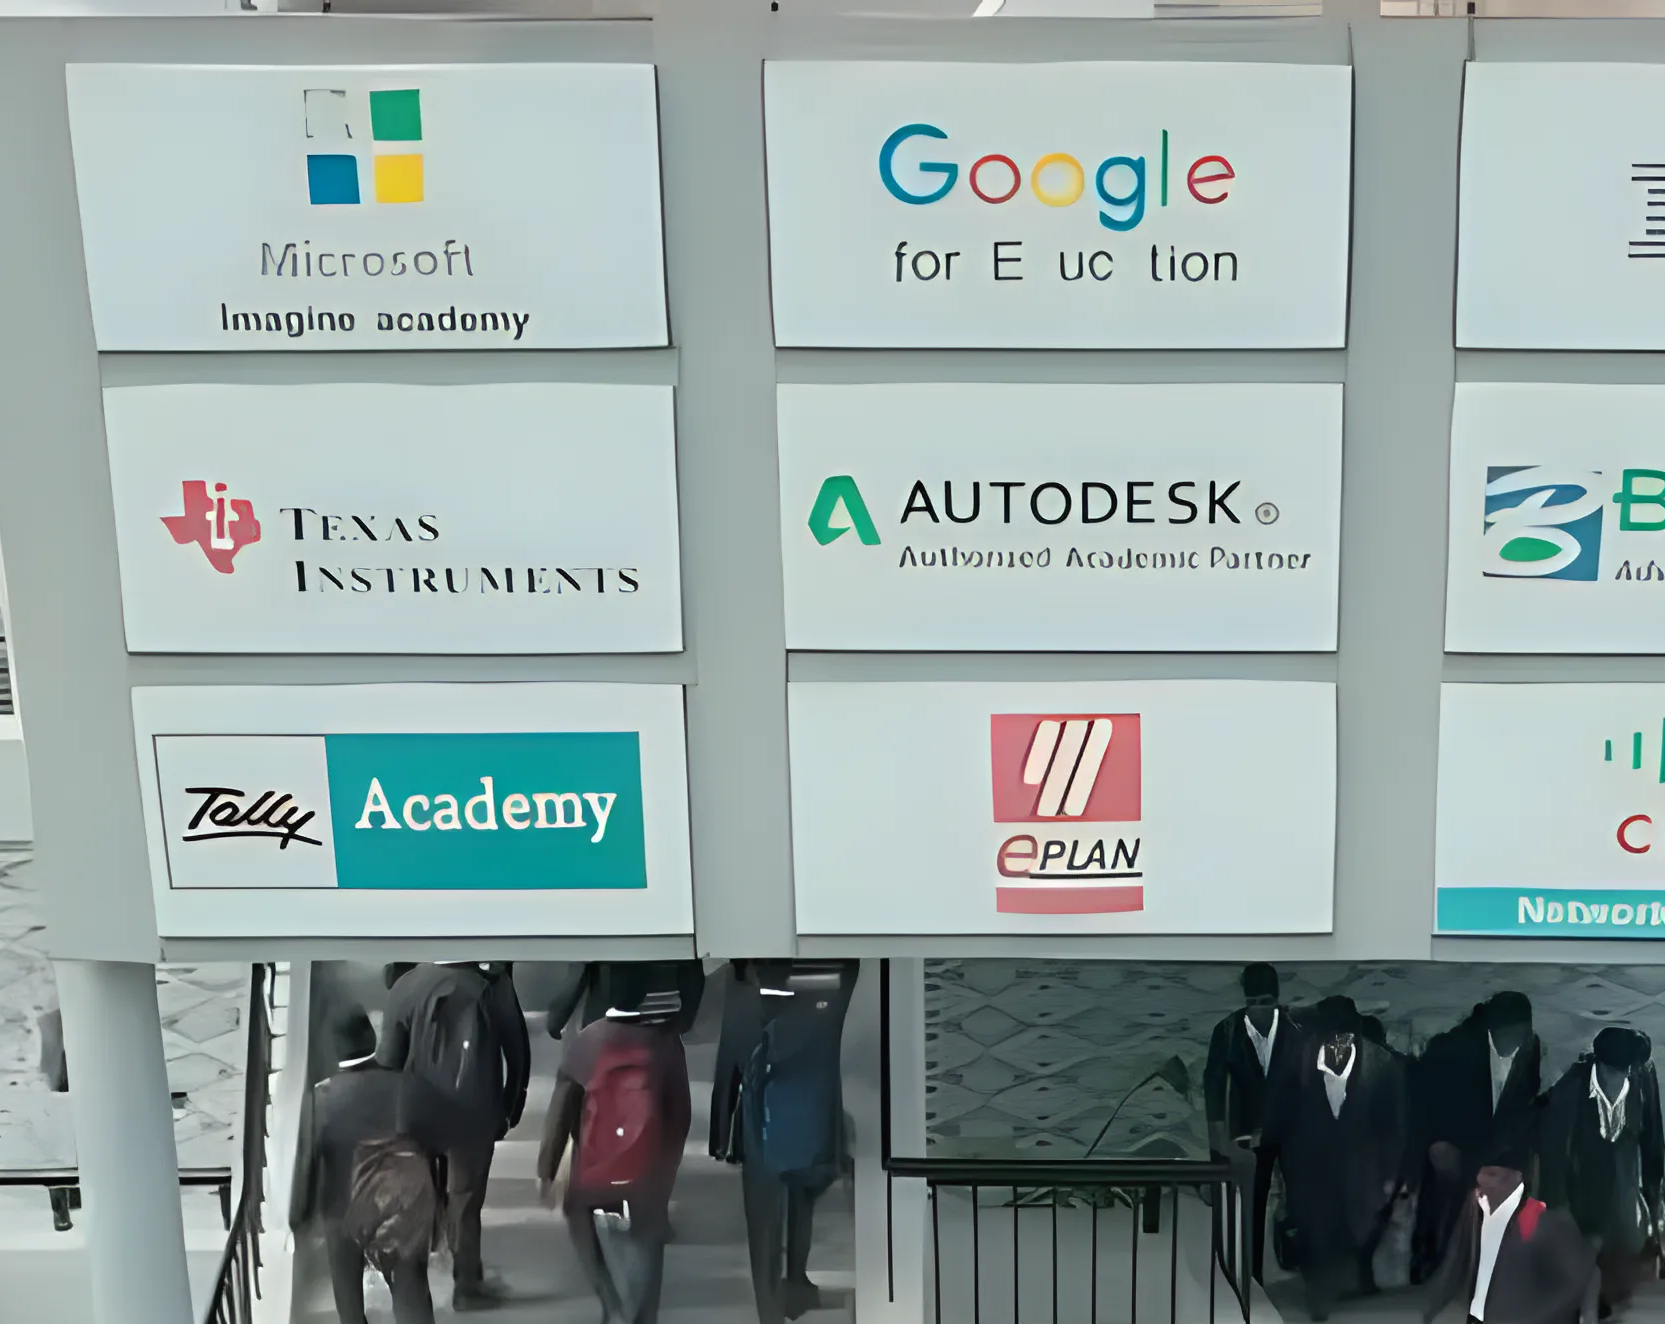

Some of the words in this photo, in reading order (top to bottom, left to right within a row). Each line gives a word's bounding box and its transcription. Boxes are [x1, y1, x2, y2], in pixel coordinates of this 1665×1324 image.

[878, 123, 1236, 232] Google
[260, 239, 474, 277] Microsoft
[894, 241, 961, 282] for
[900, 480, 1242, 525] AUTODESK
[279, 508, 440, 542] TEXAS
[295, 560, 640, 595] INSTRUMENTS
[182, 787, 323, 850] Tally
[354, 776, 619, 844] Academy
